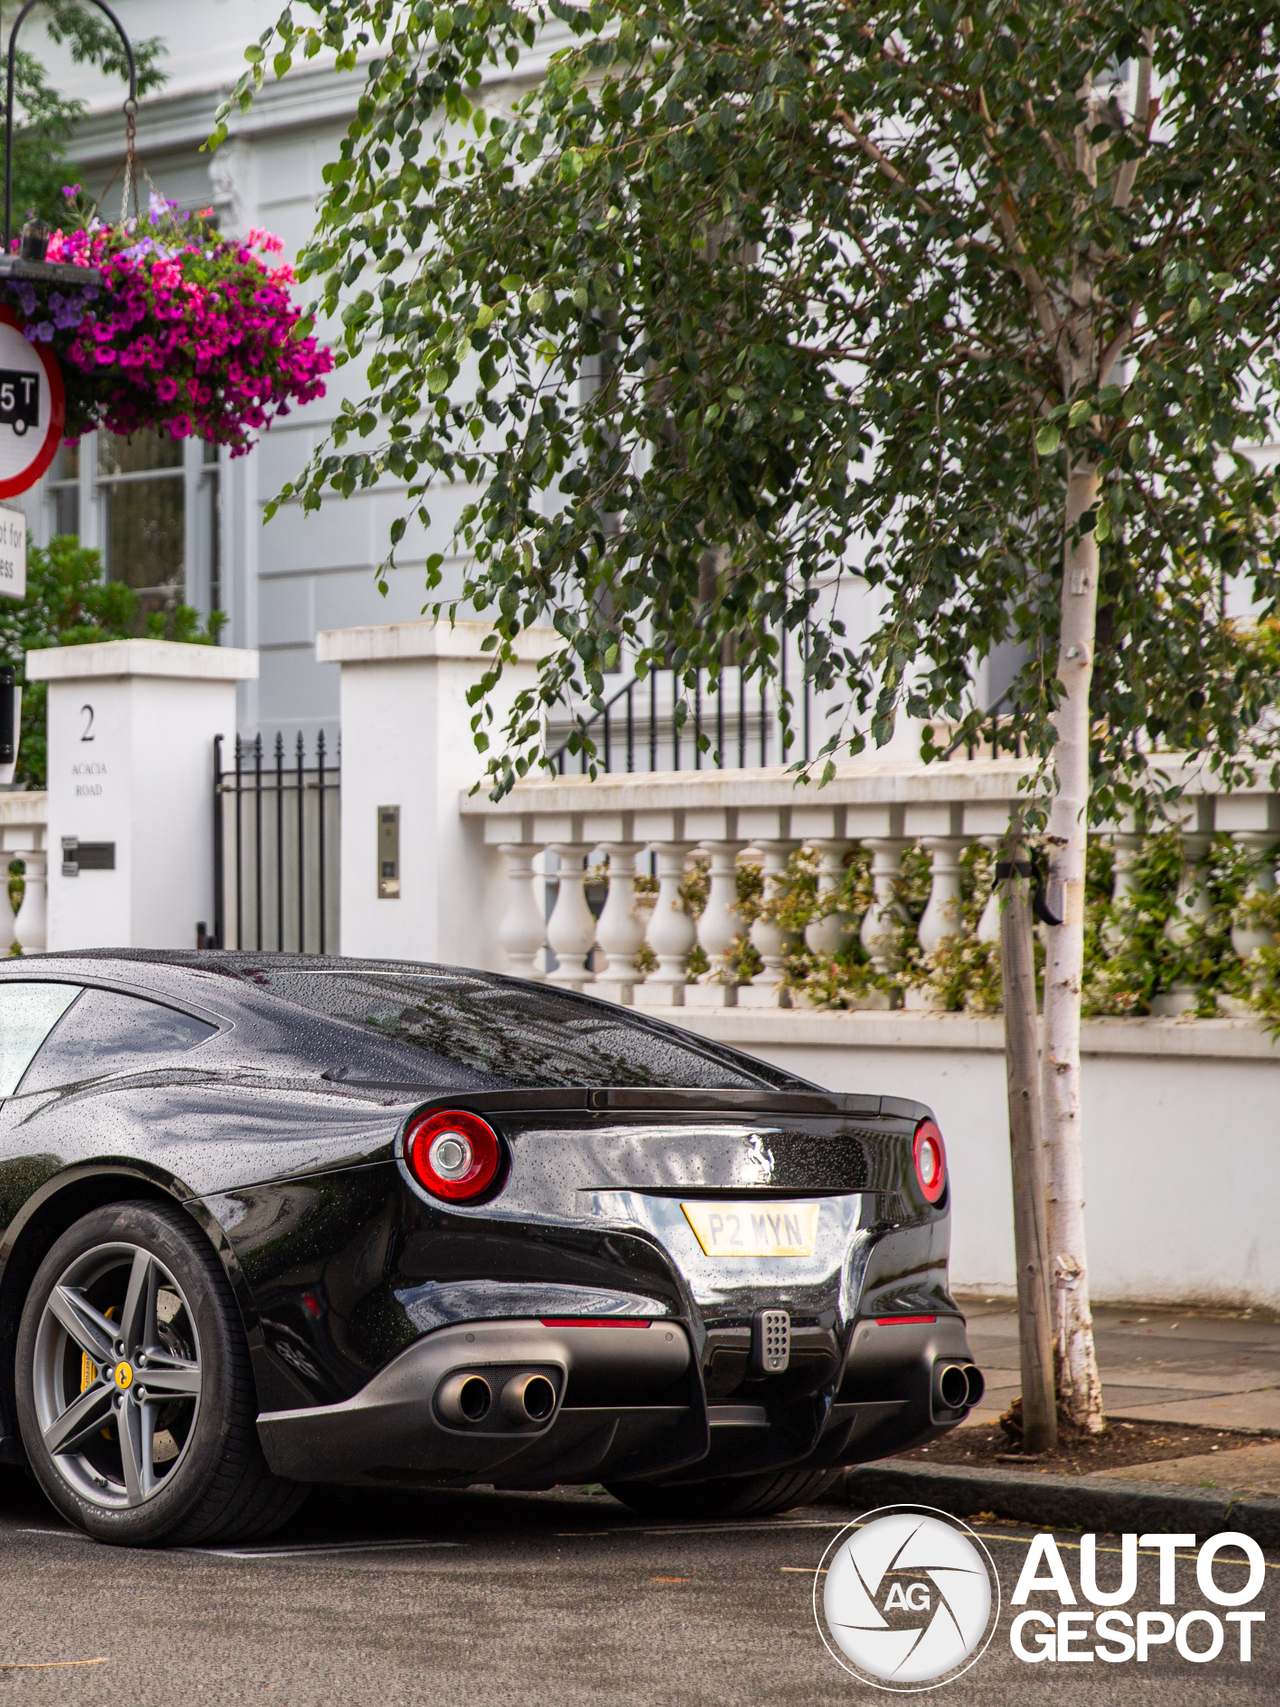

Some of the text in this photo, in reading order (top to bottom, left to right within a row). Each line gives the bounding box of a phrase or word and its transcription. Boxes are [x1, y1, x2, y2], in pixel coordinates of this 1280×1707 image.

[9, 525, 23, 549] for
[80, 703, 96, 742] 2
[71, 762, 107, 775] ACACIA
[75, 783, 103, 797] ROAD
[708, 1213, 804, 1247] P2 MYN
